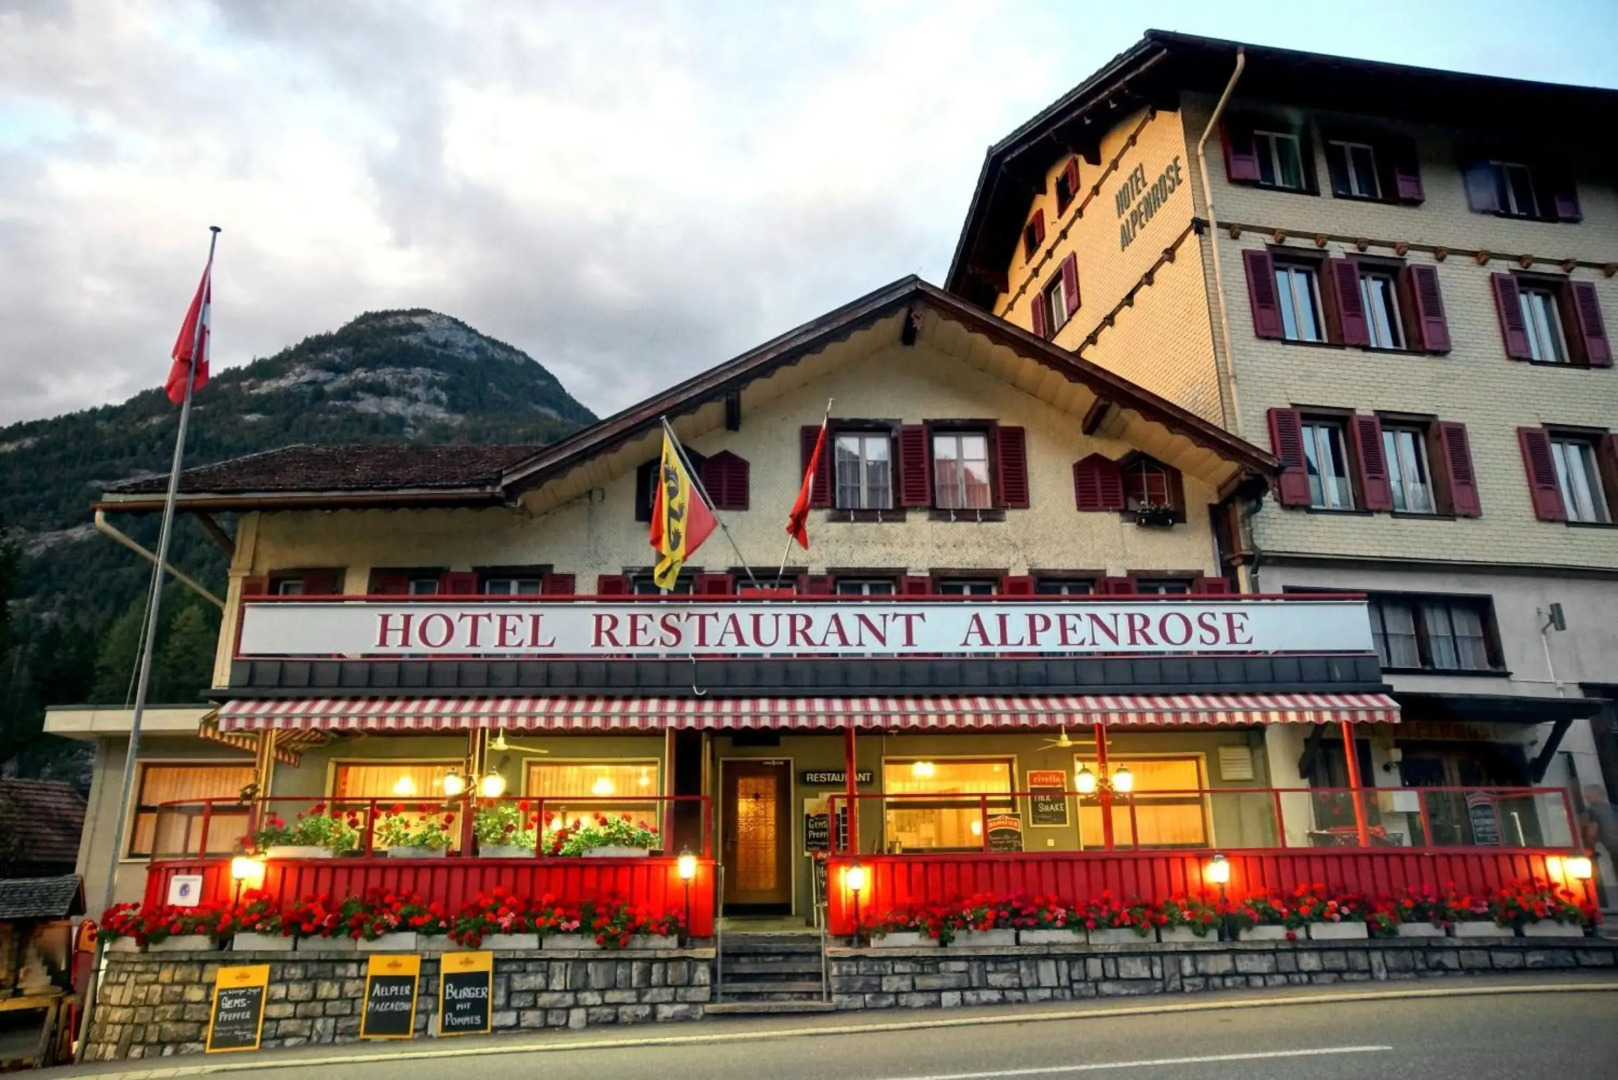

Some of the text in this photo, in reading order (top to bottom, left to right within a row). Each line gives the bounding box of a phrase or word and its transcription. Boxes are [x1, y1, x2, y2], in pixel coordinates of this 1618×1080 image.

[1115, 162, 1148, 219] HOTEL
[1120, 155, 1183, 252] ALPENROSE
[375, 611, 1253, 648] HOTEL RESTAURANT ALPENROSE
[1033, 774, 1061, 783] rivella
[1038, 803, 1065, 813] SHAKE
[371, 982, 411, 997] AELPLER
[445, 983, 488, 1000] BURGER
[456, 1002, 472, 1010] MIT
[218, 1011, 251, 1022] PFEFFER
[445, 1012, 482, 1026] POMMES
